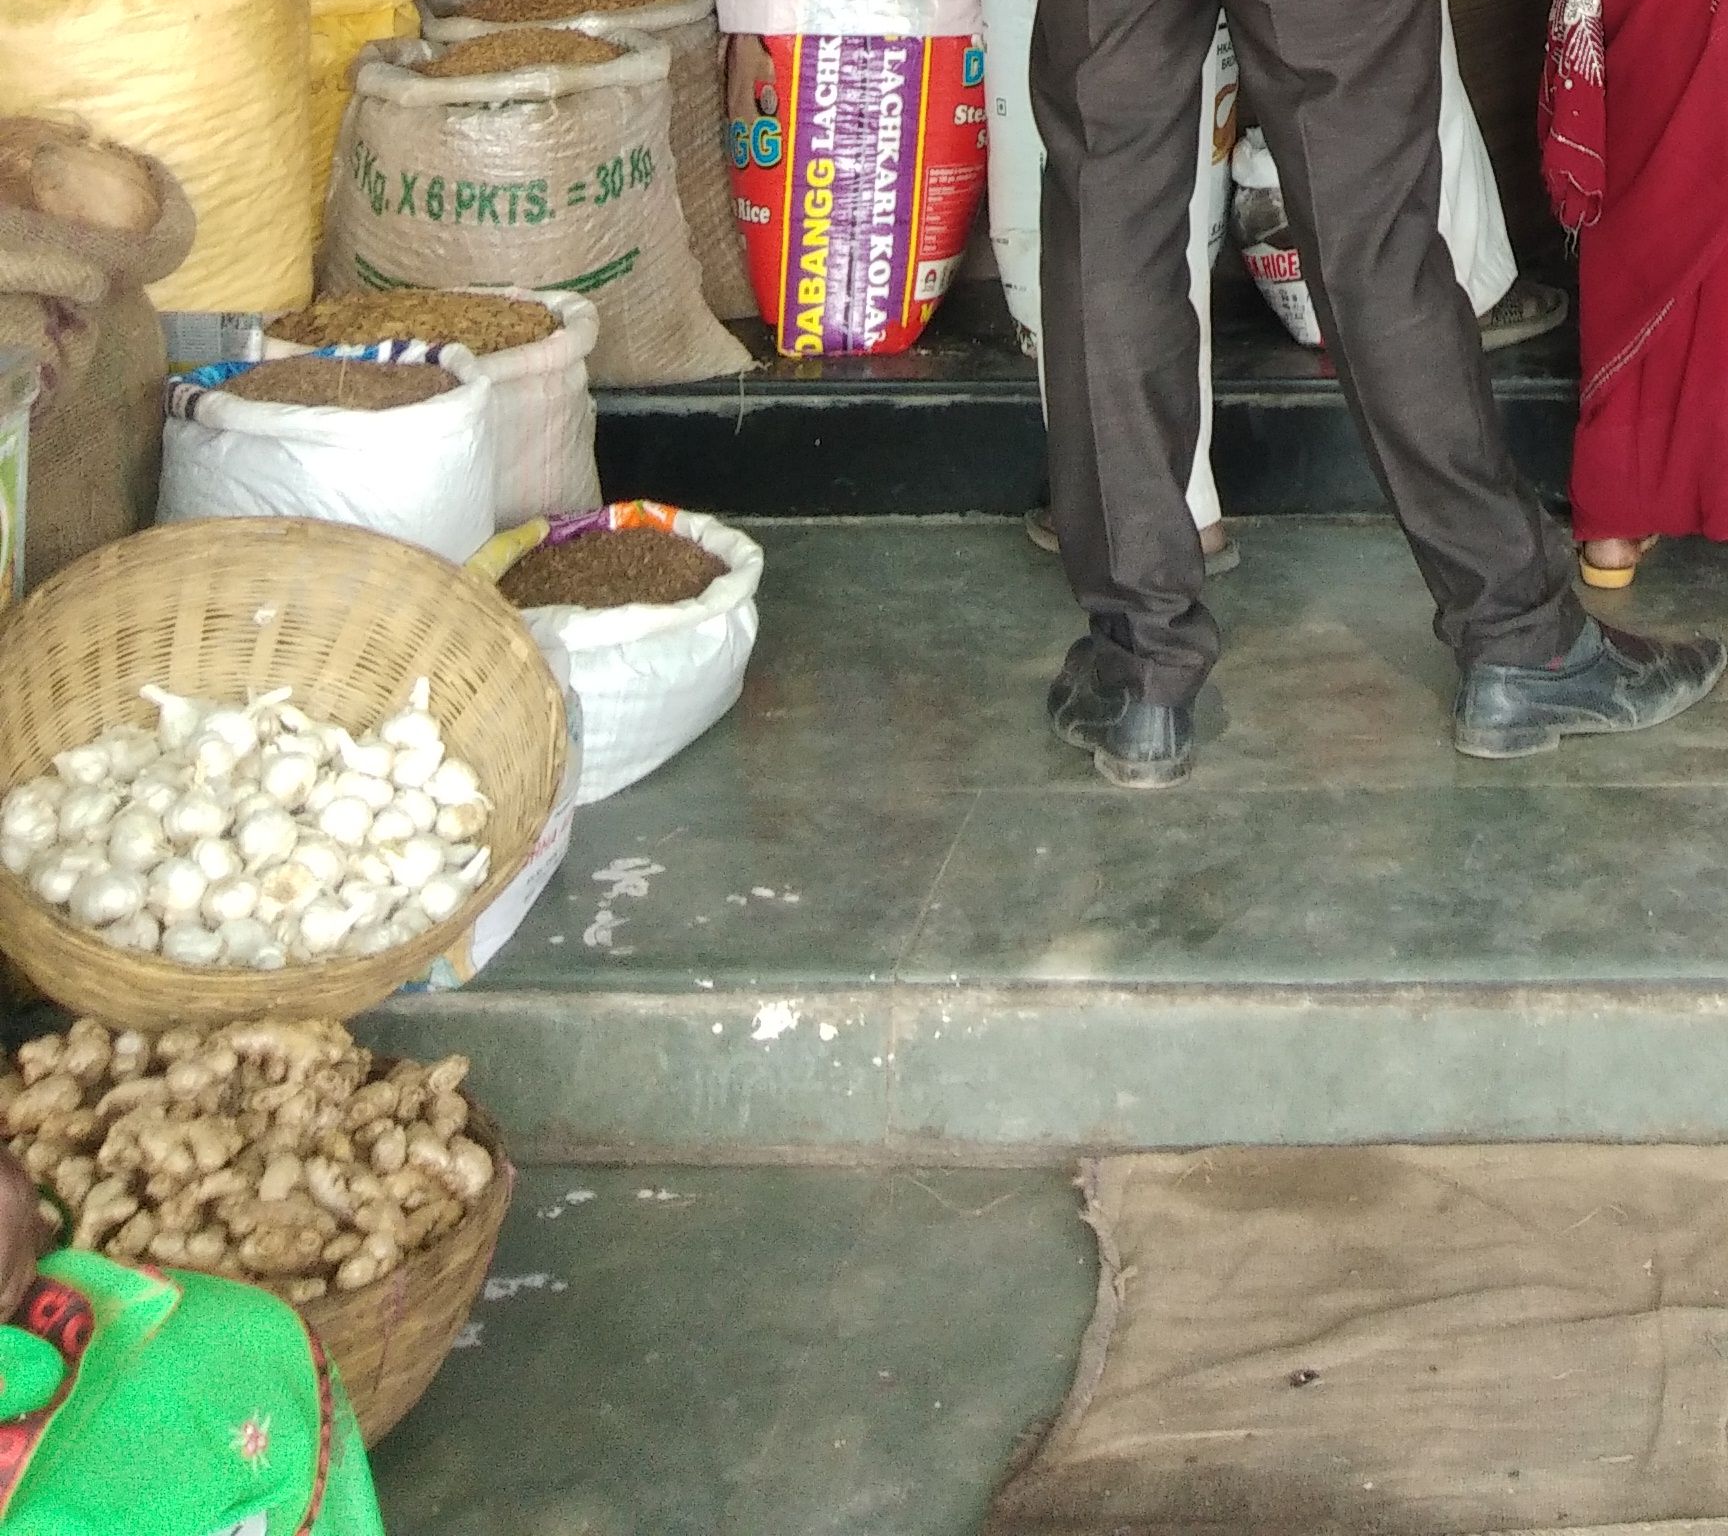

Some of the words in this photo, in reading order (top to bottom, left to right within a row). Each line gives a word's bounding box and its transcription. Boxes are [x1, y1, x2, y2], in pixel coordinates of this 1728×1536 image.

[812, 36, 843, 152] LACHK
[873, 47, 907, 226] LACHKARI
[427, 174, 444, 221] 6
[795, 158, 836, 355] DABANGG
